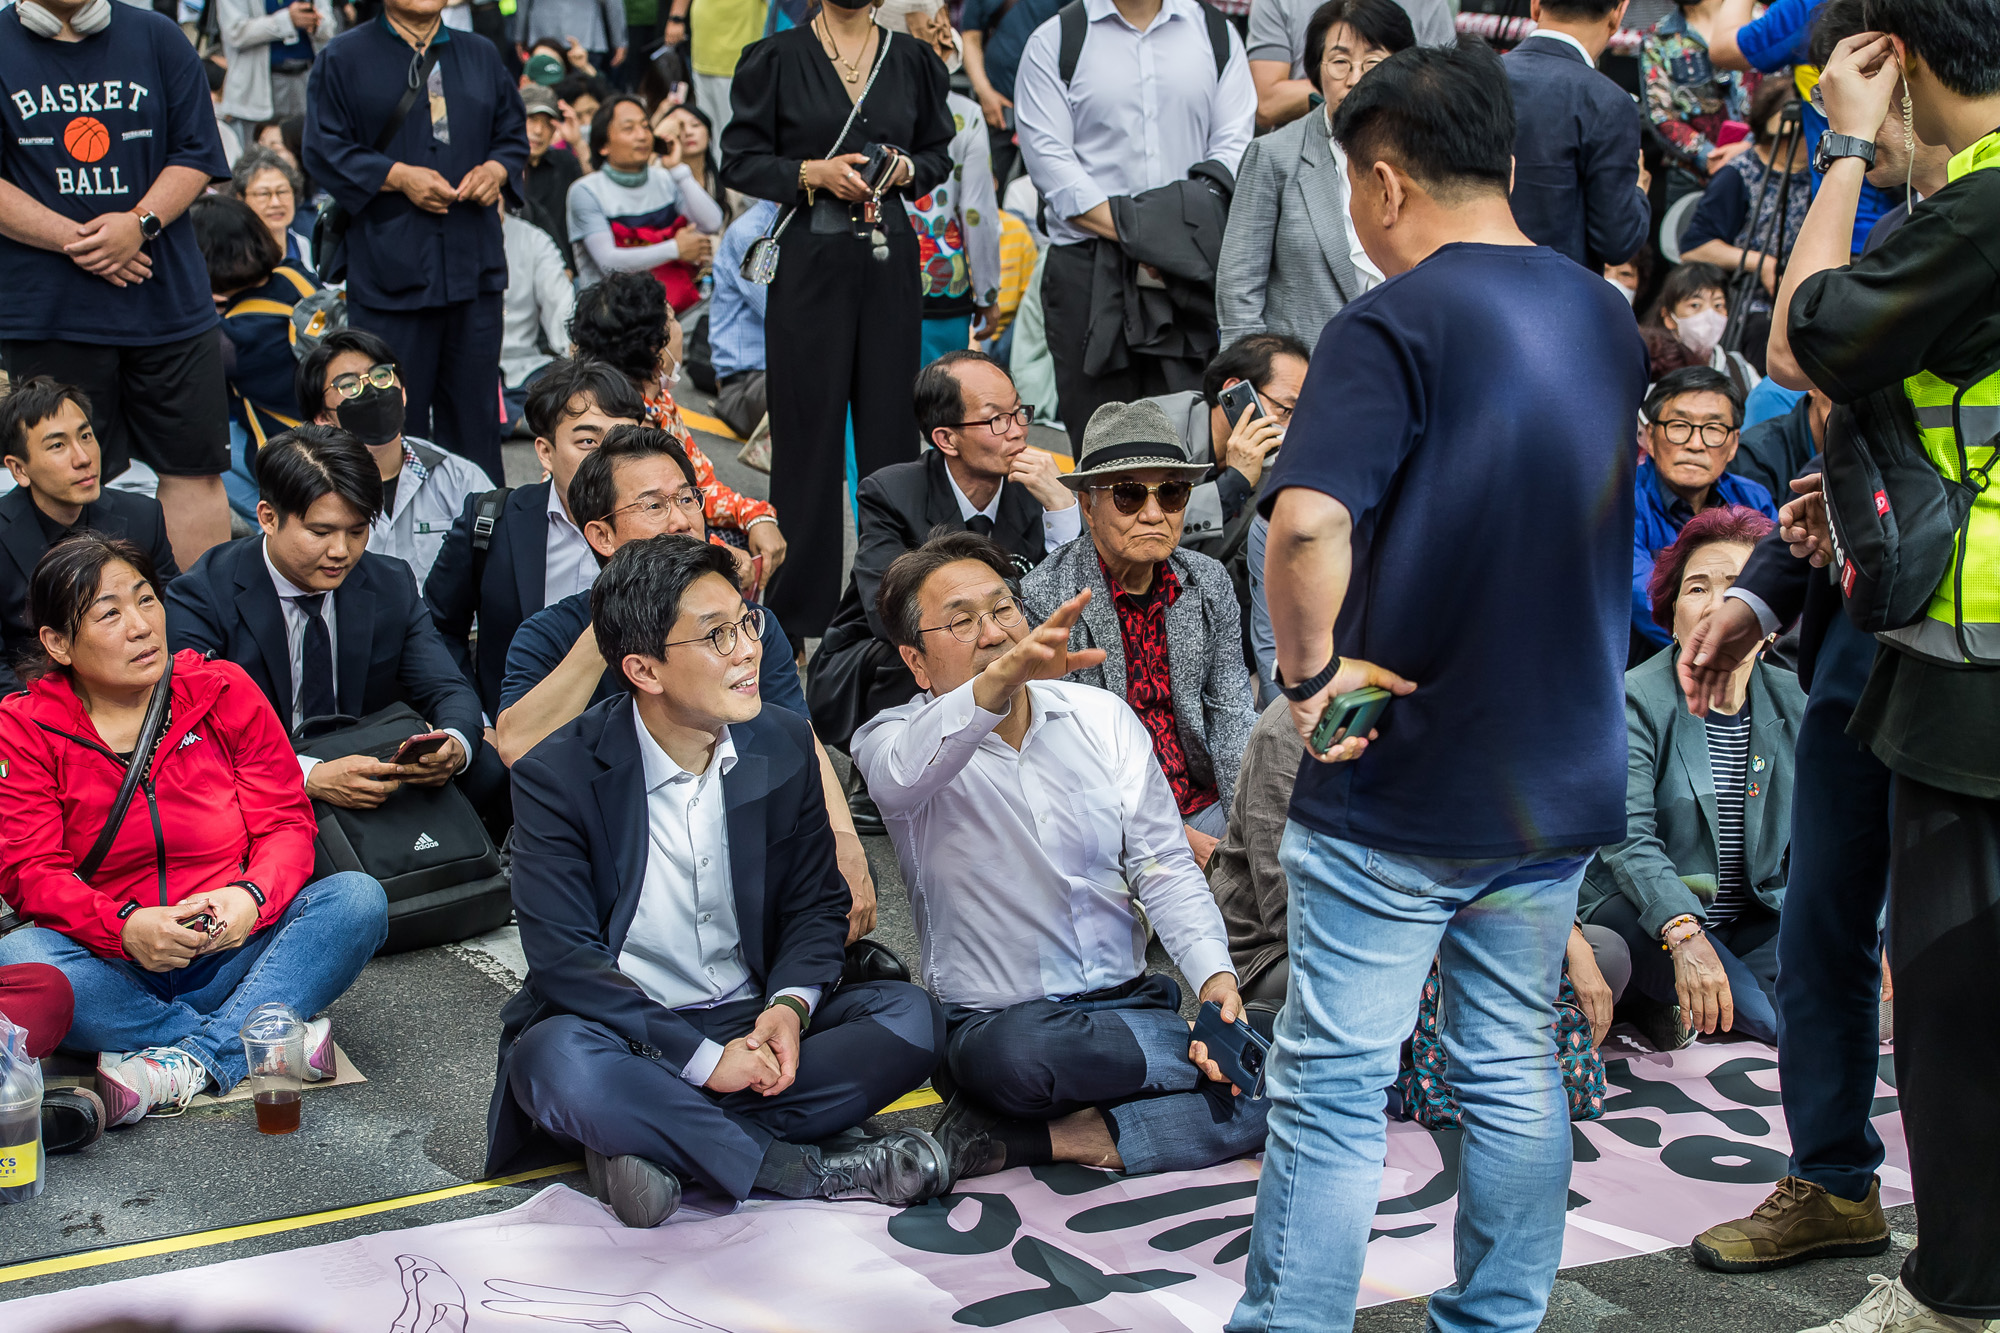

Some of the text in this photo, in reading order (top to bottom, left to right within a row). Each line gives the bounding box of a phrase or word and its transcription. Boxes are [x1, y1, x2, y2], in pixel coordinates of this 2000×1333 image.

[11, 80, 149, 121] BASKET
[56, 166, 129, 195] BALL
[413, 840, 440, 851] adidas
